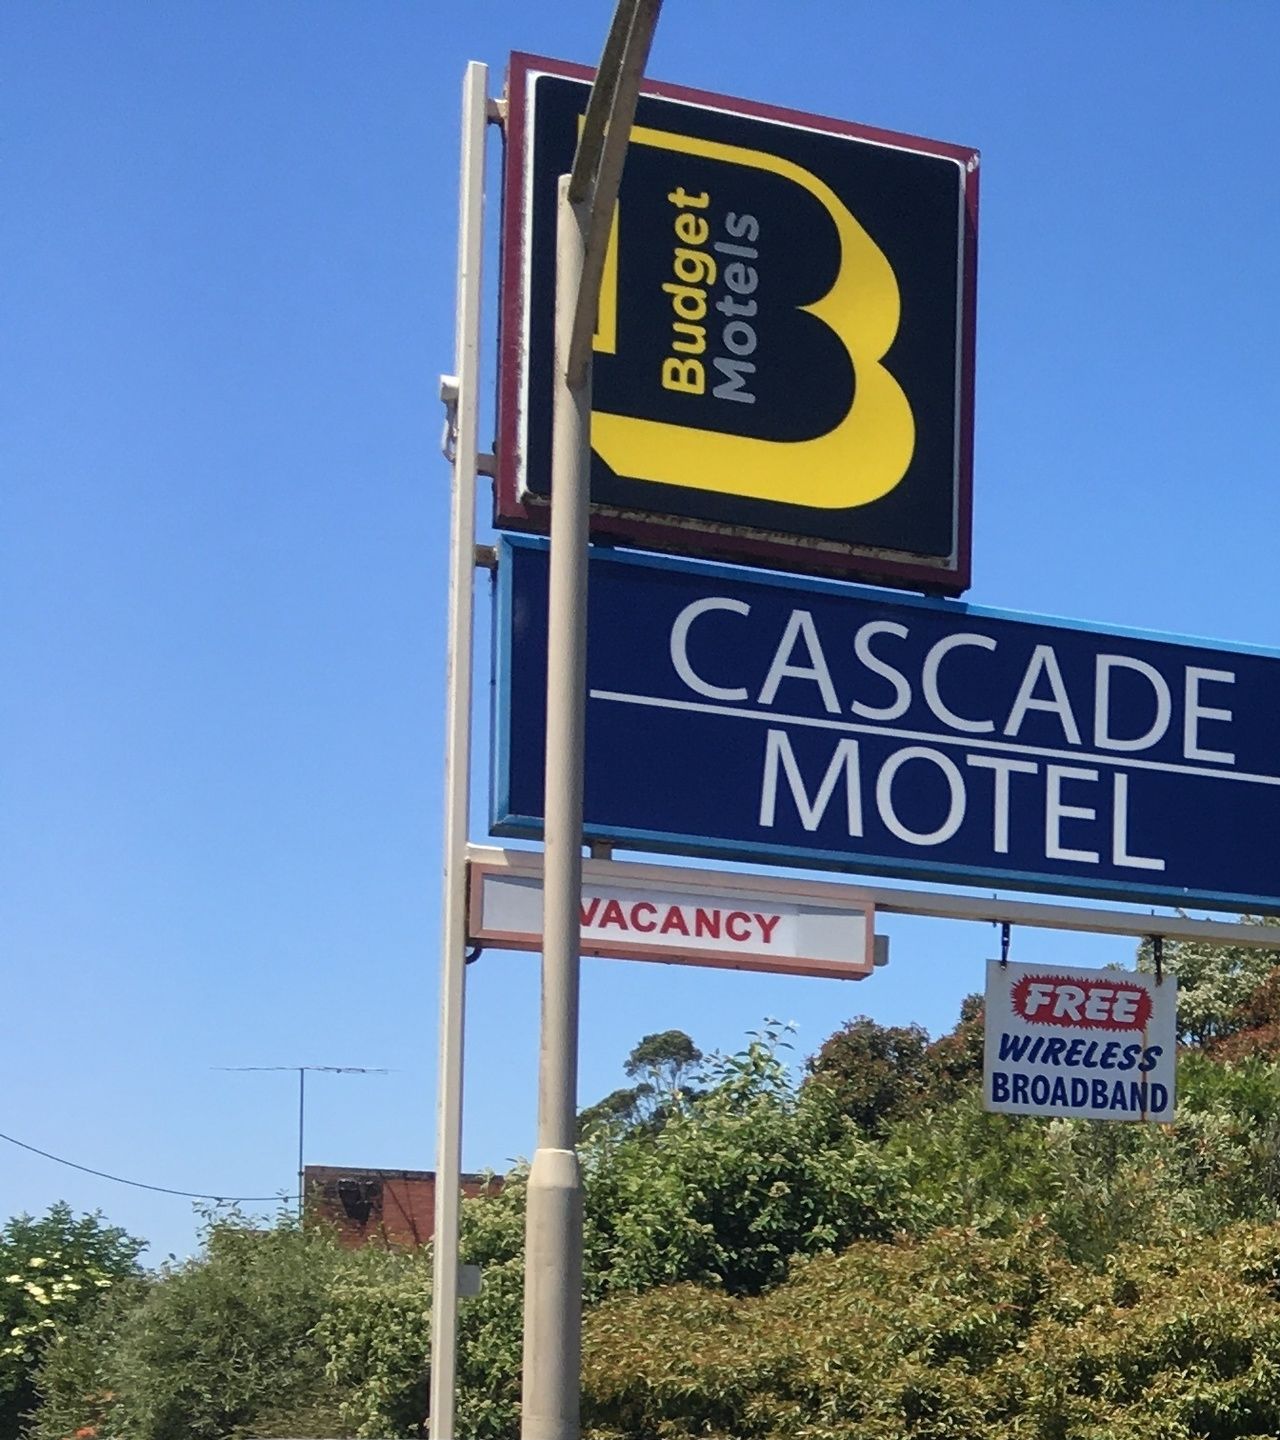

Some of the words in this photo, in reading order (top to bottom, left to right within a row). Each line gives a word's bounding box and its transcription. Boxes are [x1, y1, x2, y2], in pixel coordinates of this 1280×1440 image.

[661, 186, 716, 396] Budget
[712, 210, 760, 405] Motels
[669, 596, 1237, 766] CASCADE
[758, 728, 1166, 872] MOTEL
[578, 898, 781, 944] VACANCY
[1024, 983, 1142, 1023] FREE
[991, 1071, 1169, 1113] BROADBAND
[998, 1032, 1164, 1072] WIRELESS
